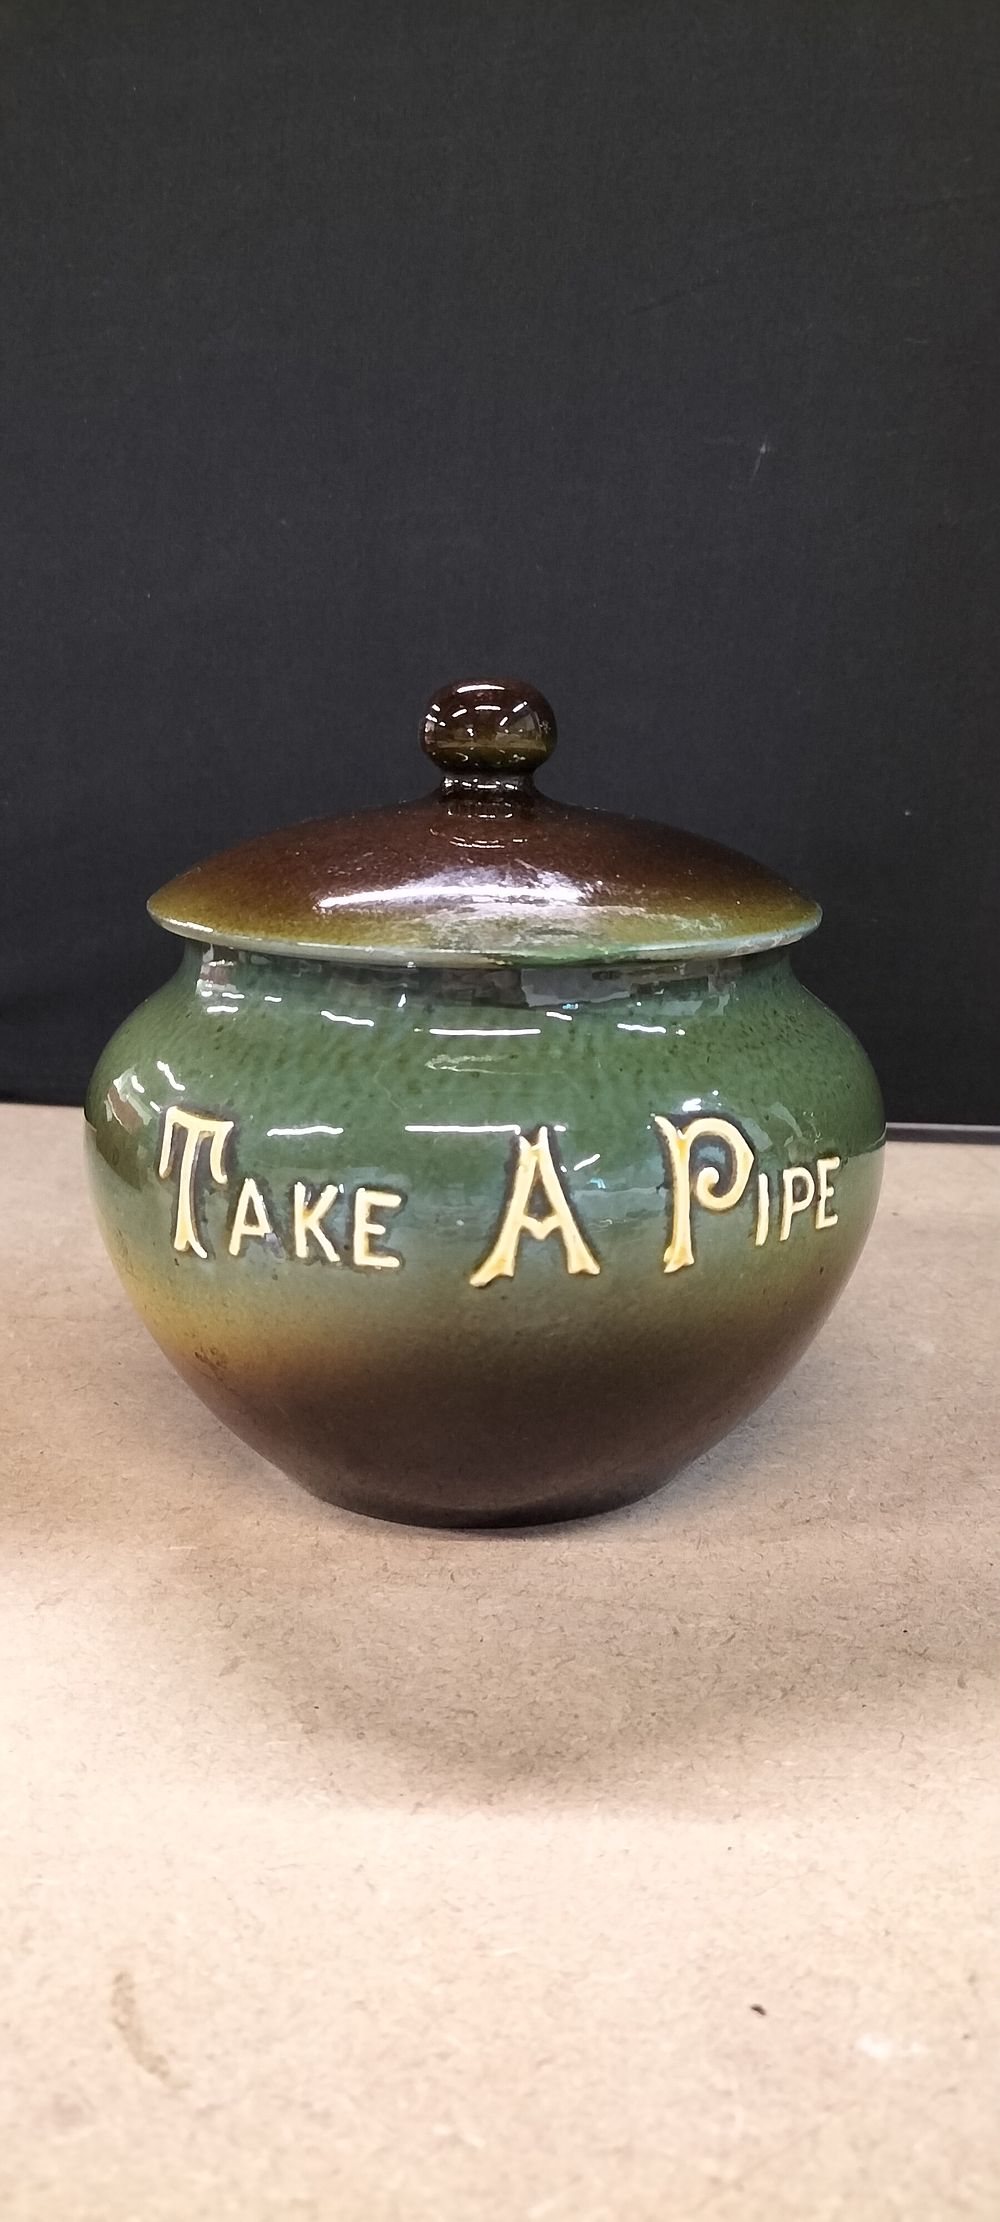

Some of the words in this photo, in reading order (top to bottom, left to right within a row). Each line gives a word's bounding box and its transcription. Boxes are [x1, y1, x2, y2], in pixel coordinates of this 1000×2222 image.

[158, 1106, 402, 1268] TAKE
[468, 1126, 600, 1288] A
[654, 1115, 841, 1274] PIPE
